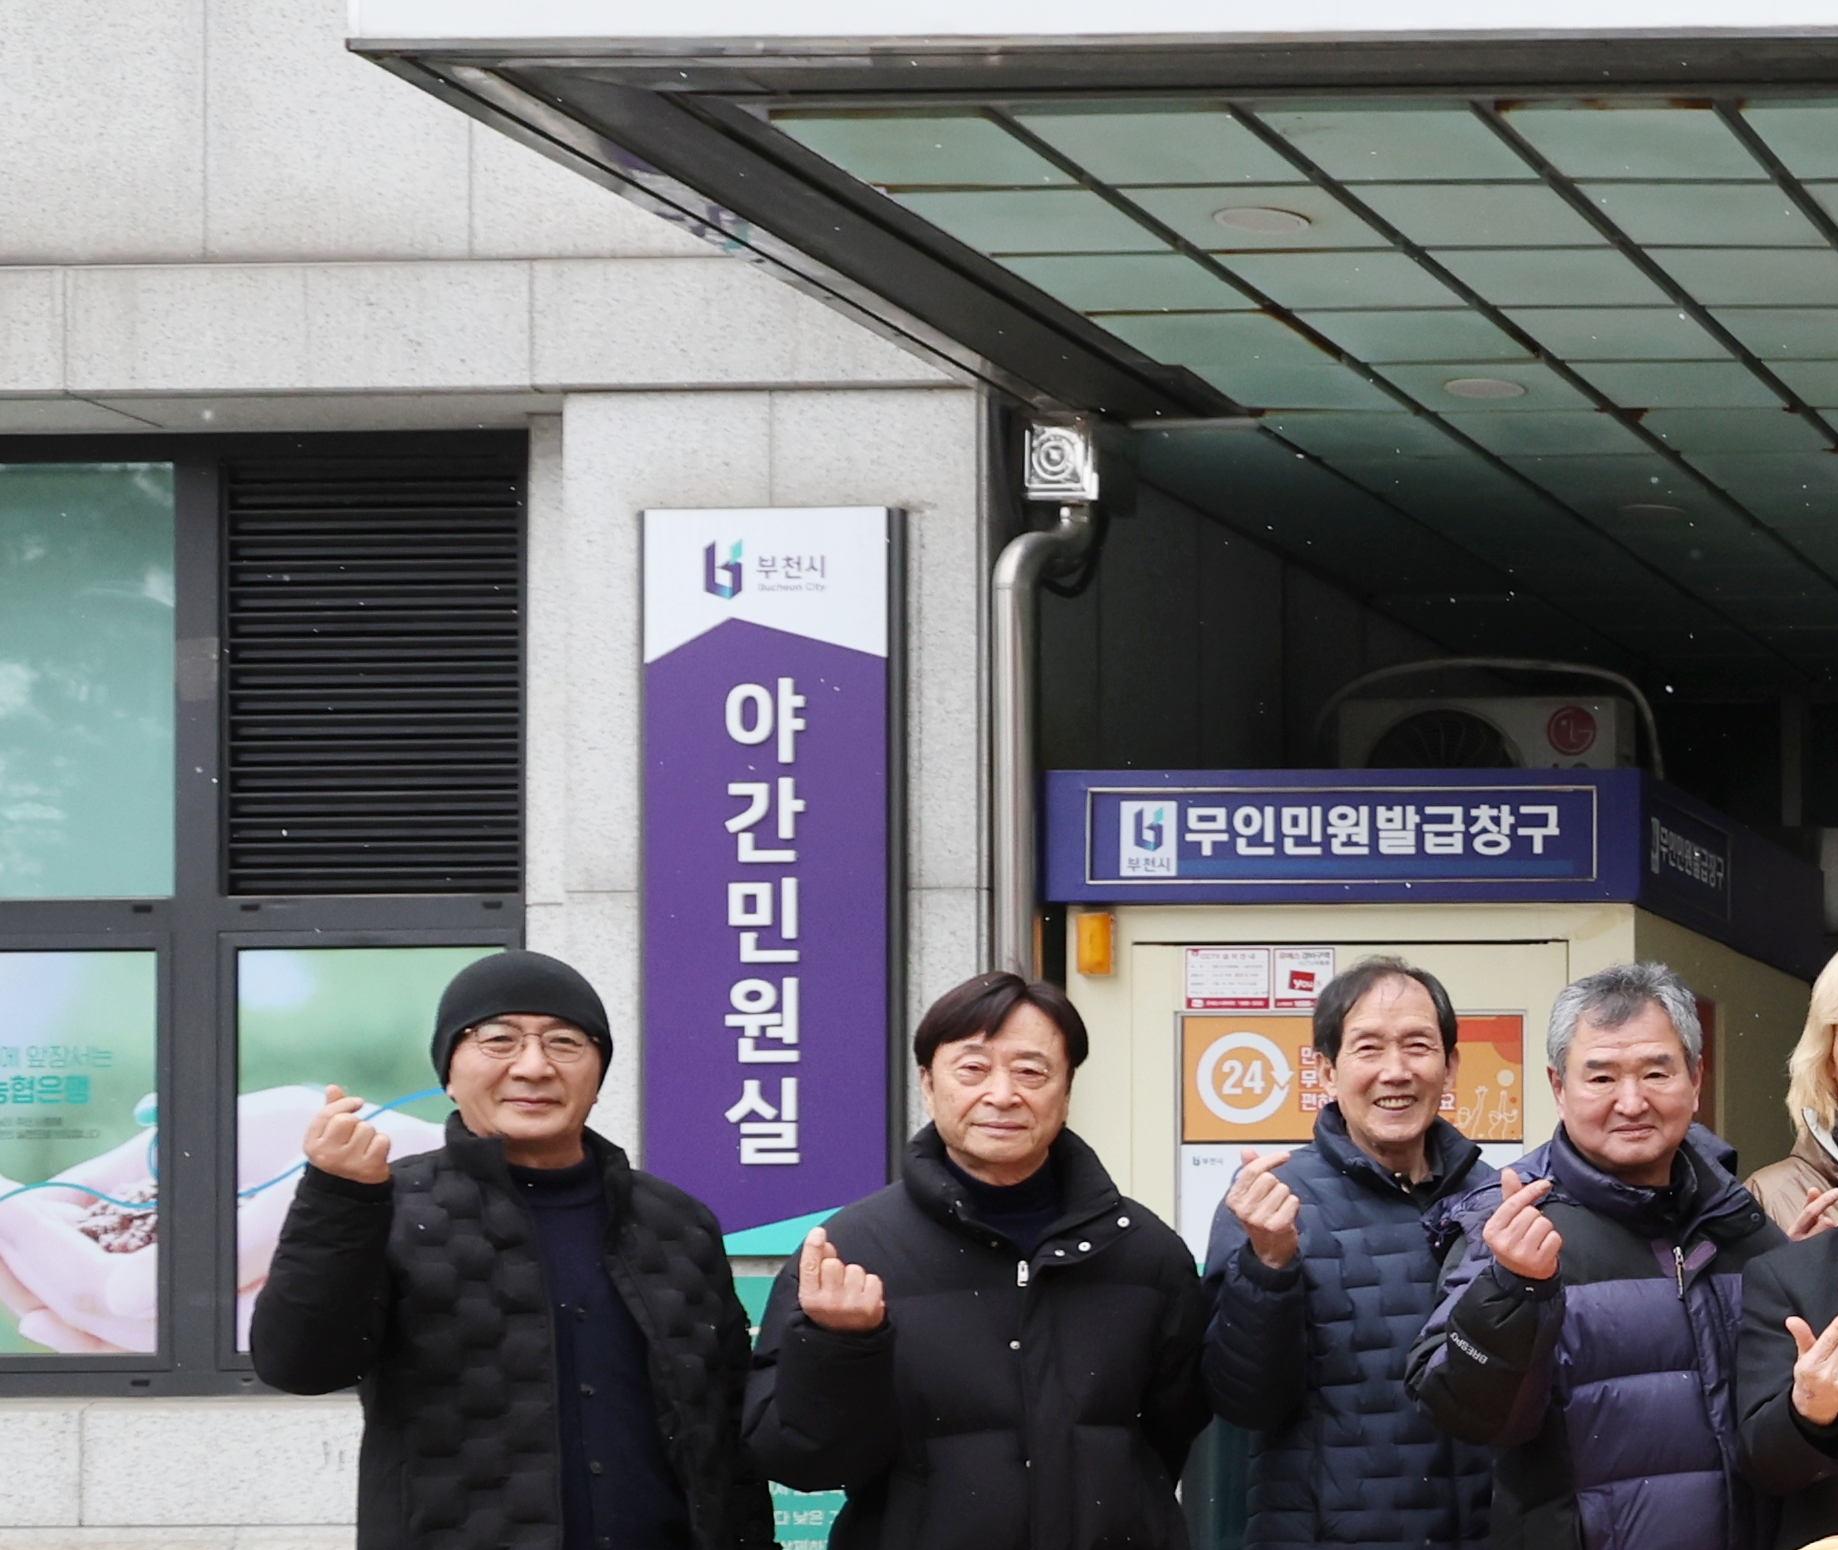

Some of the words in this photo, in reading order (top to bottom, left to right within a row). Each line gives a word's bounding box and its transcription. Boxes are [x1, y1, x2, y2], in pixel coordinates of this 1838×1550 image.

[756, 555, 826, 579] 부천시
[758, 582, 802, 592] Bucheon
[806, 582, 826, 592] City
[1184, 804, 1561, 856] 무인민원발급창구
[1126, 856, 1171, 873] 부천시
[725, 677, 806, 1165] 야간민원실
[1221, 1059, 1266, 1096] 24
